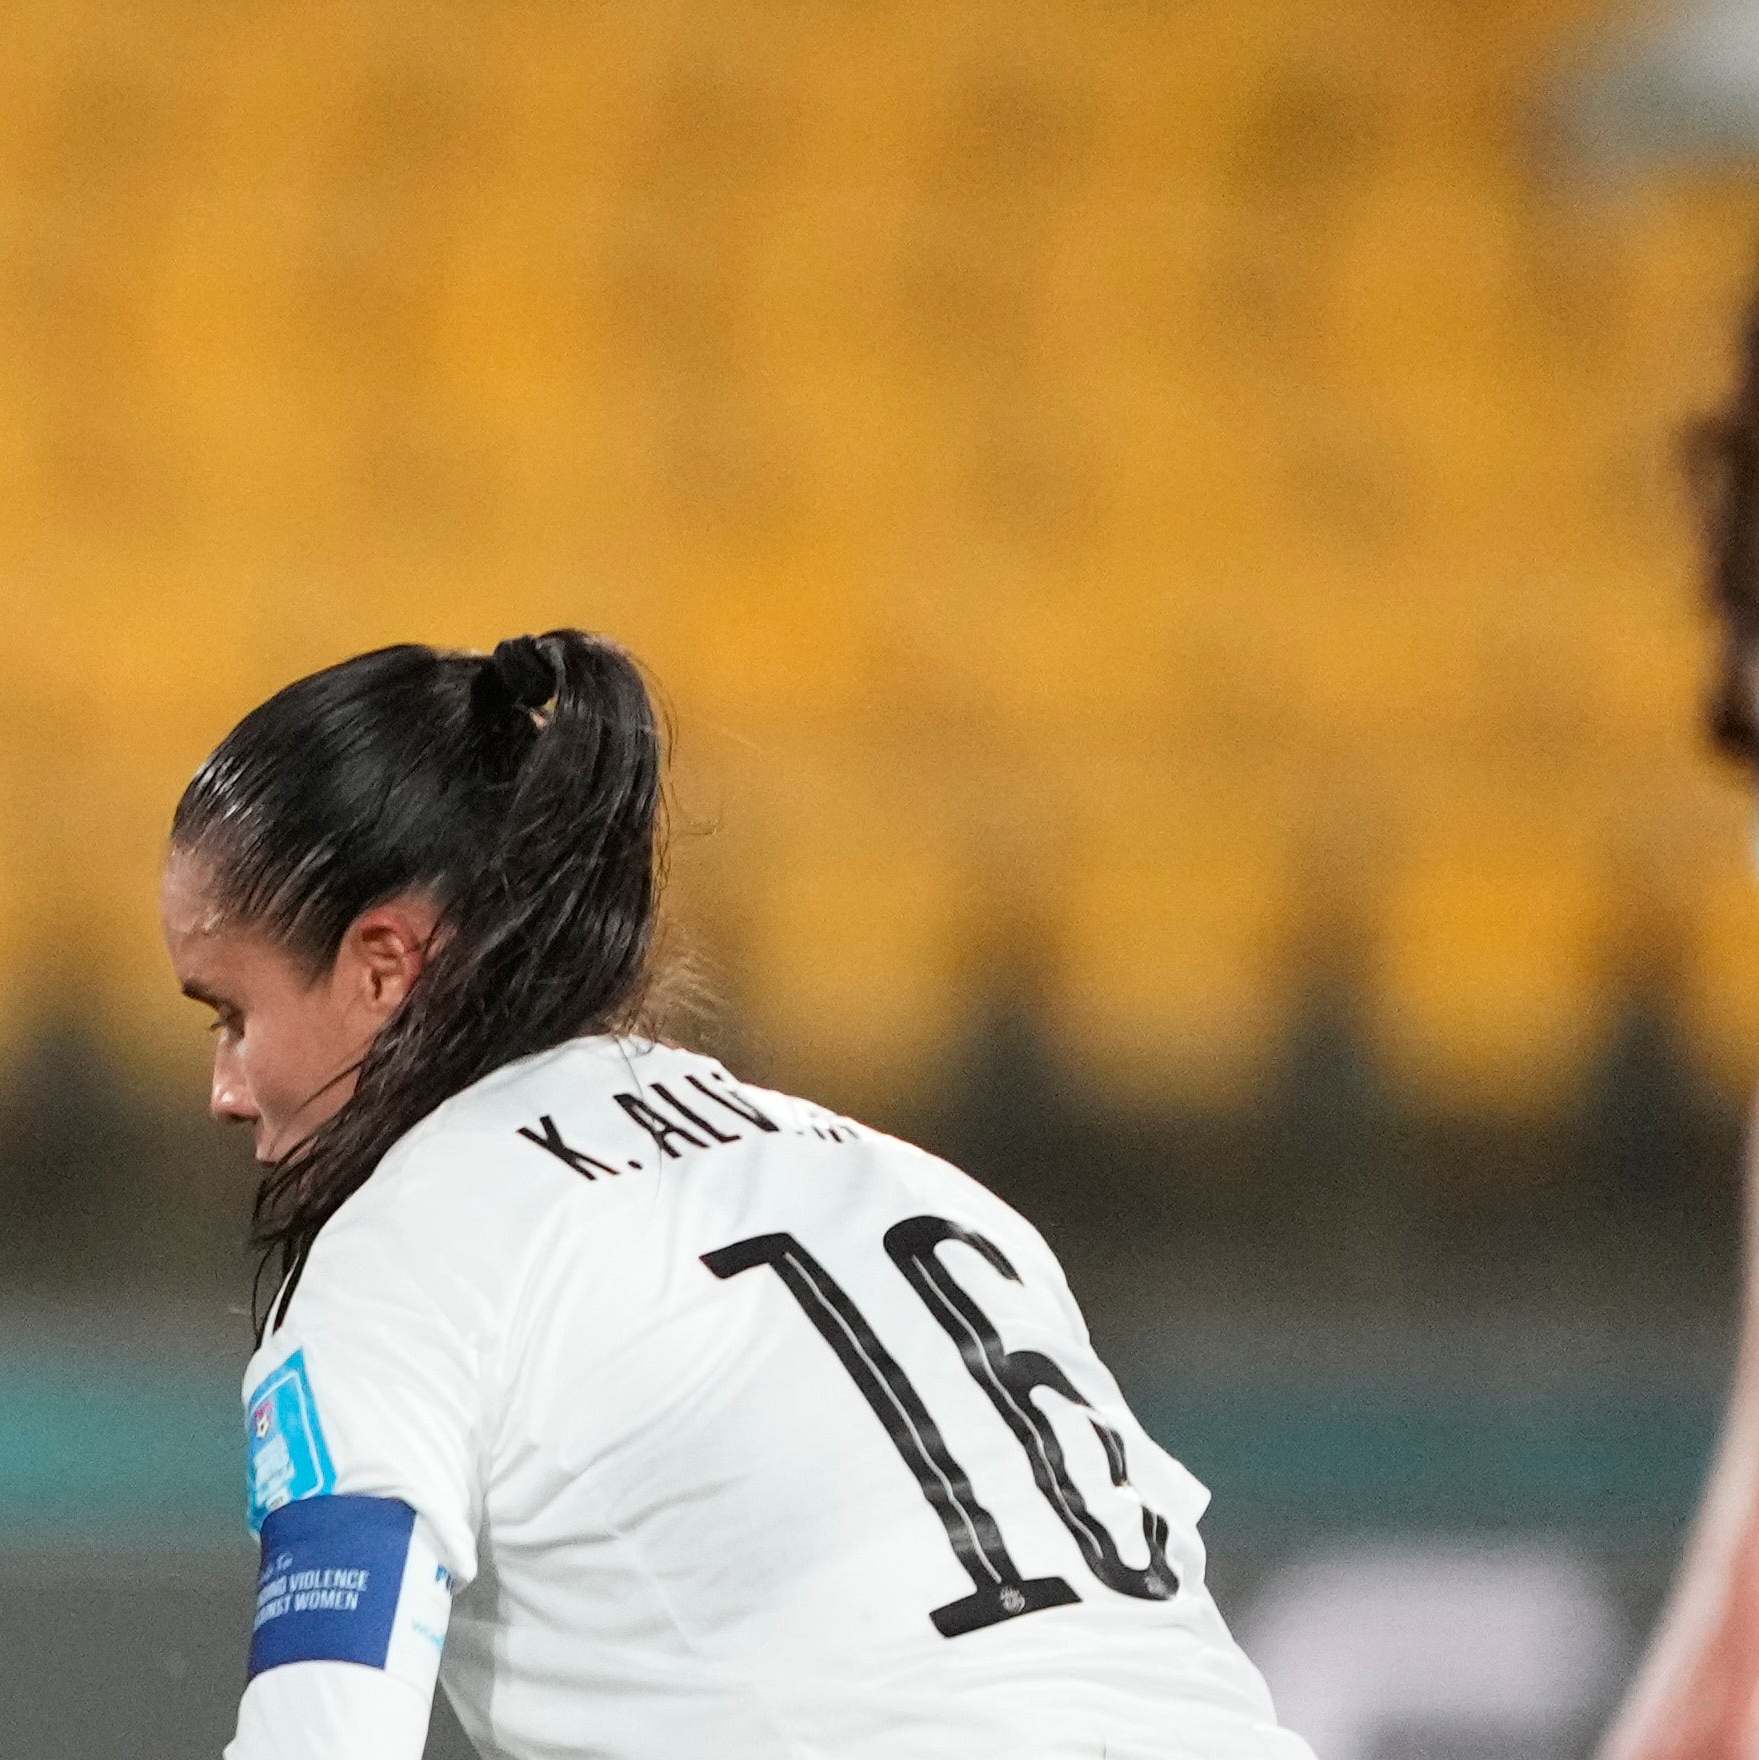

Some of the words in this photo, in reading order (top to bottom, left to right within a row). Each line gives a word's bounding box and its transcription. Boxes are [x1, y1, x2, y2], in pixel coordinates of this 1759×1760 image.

[698, 1214, 1180, 1639] 16
[290, 1568, 371, 1593] VIOLENCE
[294, 1589, 360, 1612] WOMEN
